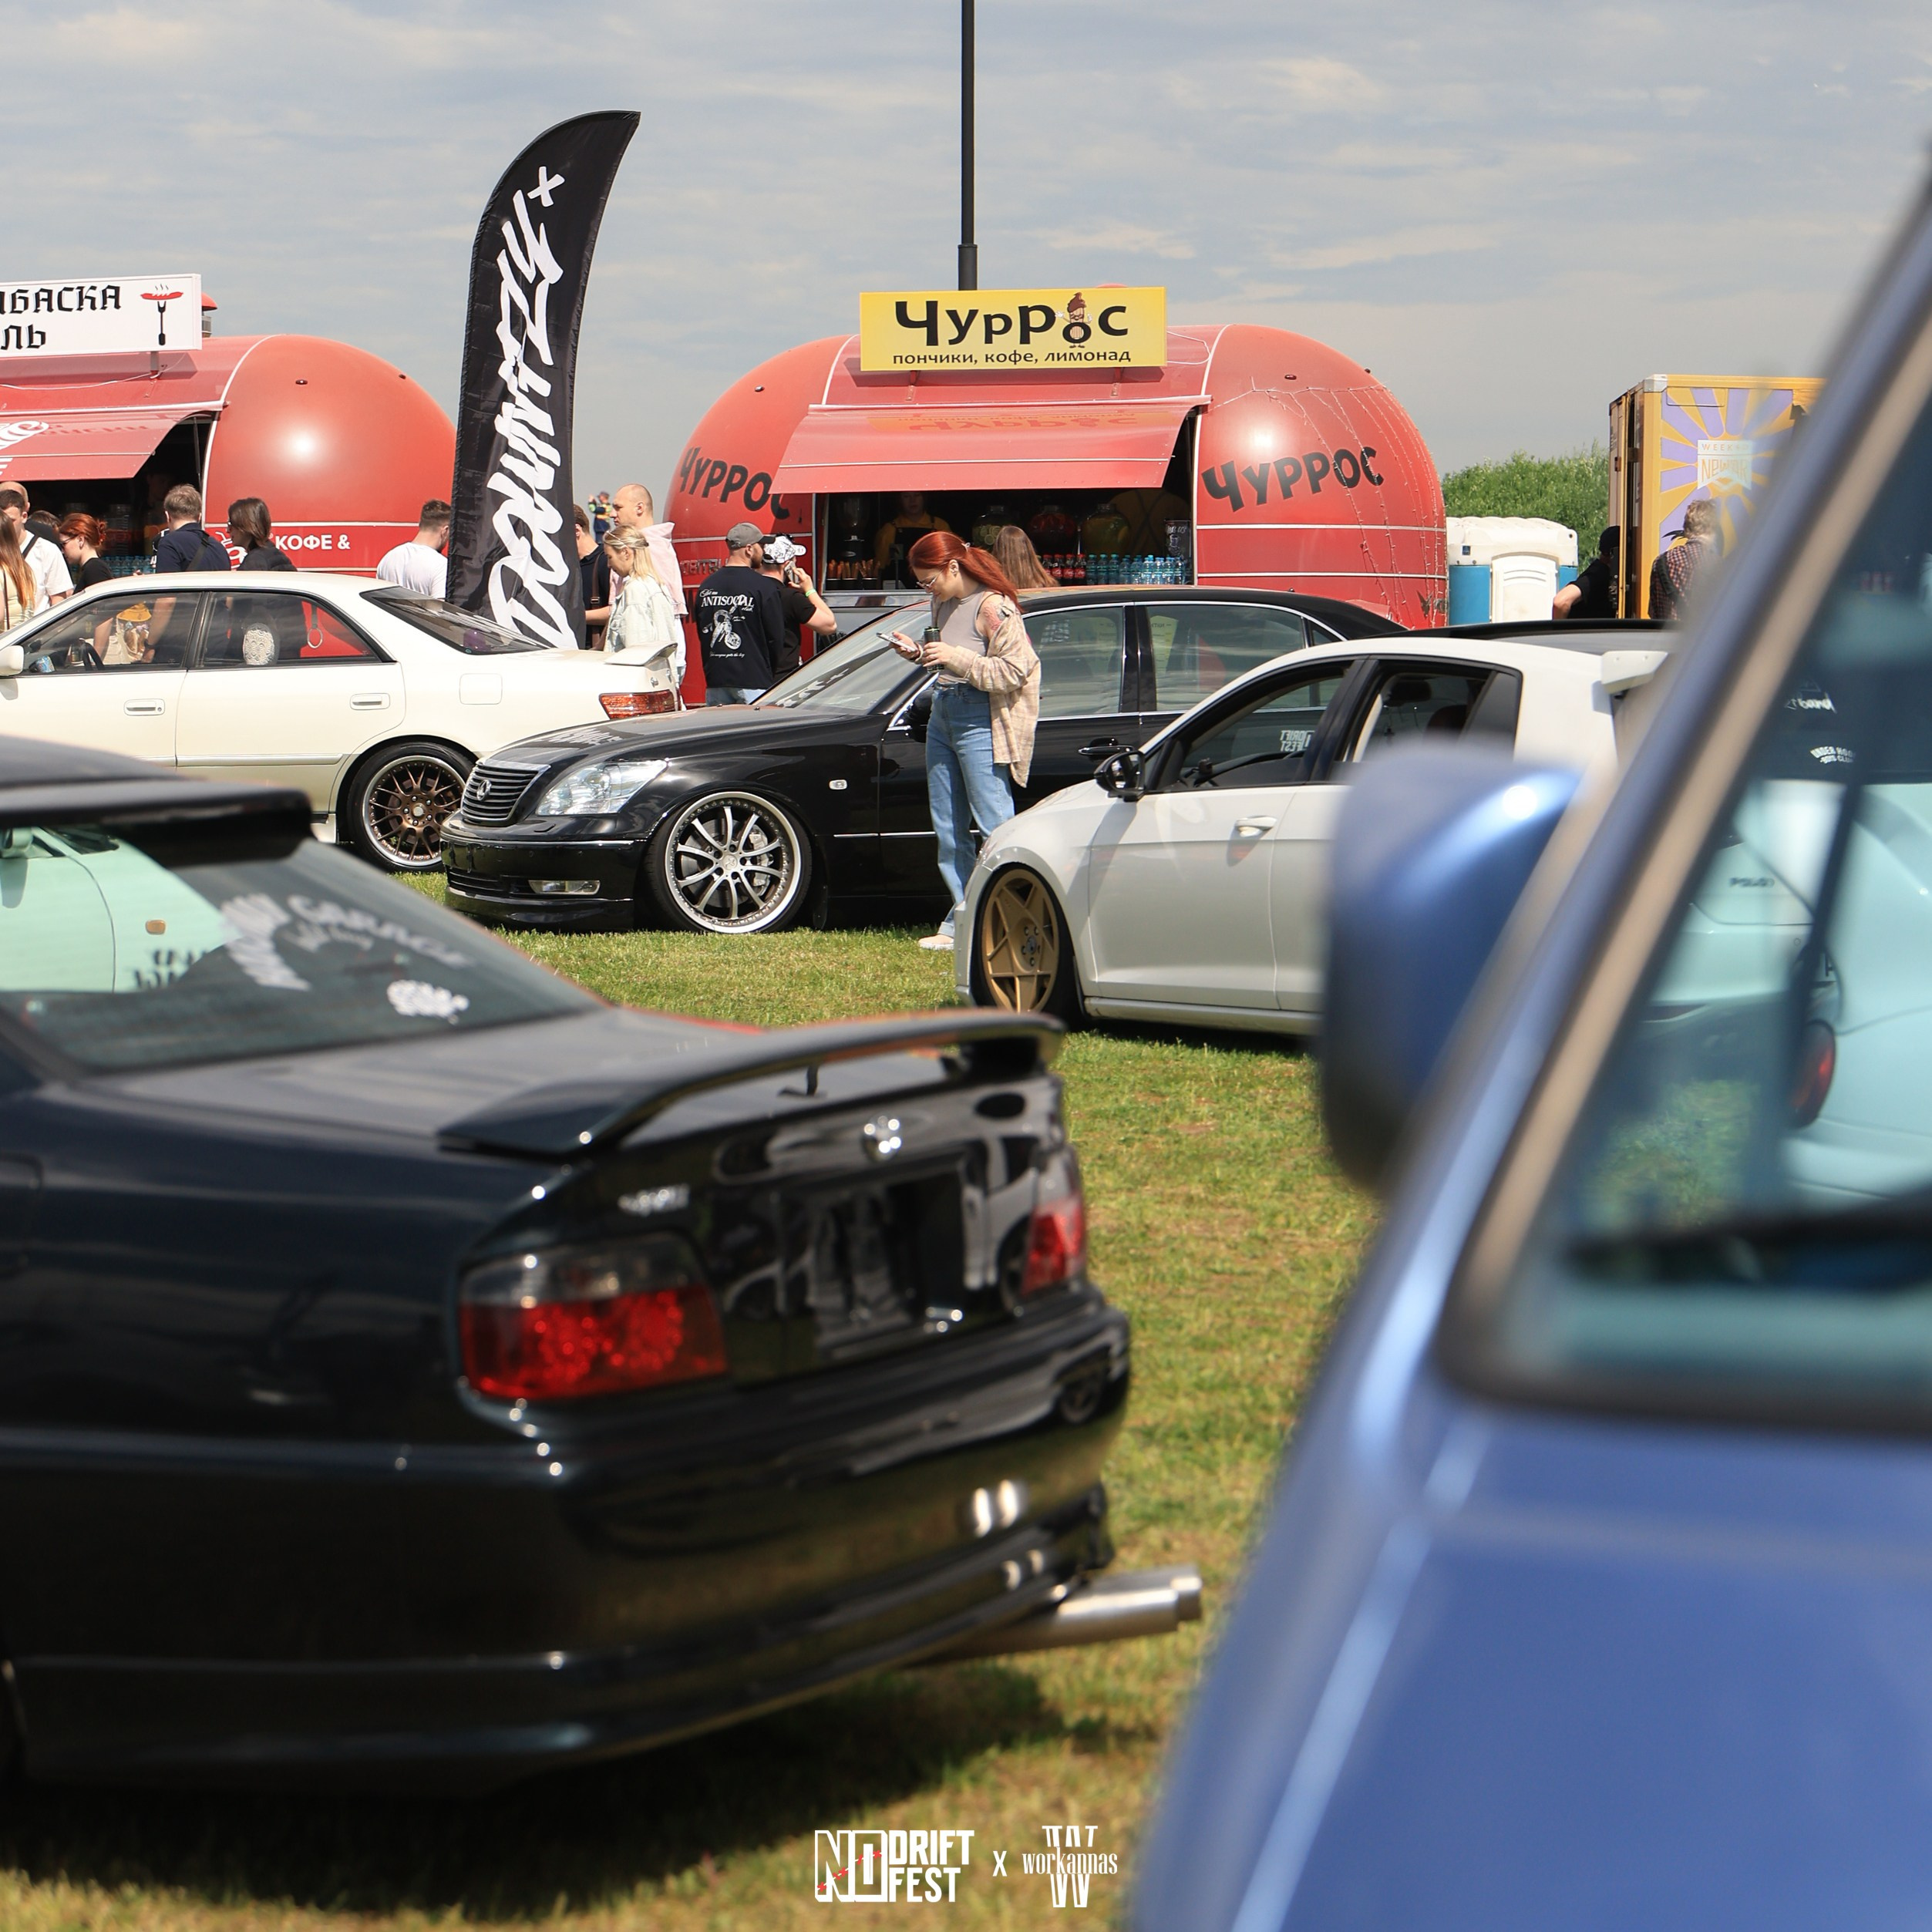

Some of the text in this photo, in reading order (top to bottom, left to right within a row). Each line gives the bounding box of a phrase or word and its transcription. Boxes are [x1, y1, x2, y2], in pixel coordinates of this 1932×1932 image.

[0, 284, 121, 315] БАСКА
[893, 350, 1131, 365] пончики, кофе, лимонад
[1201, 446, 1385, 513] ЧУРРОС
[275, 534, 332, 551] КОФЕ
